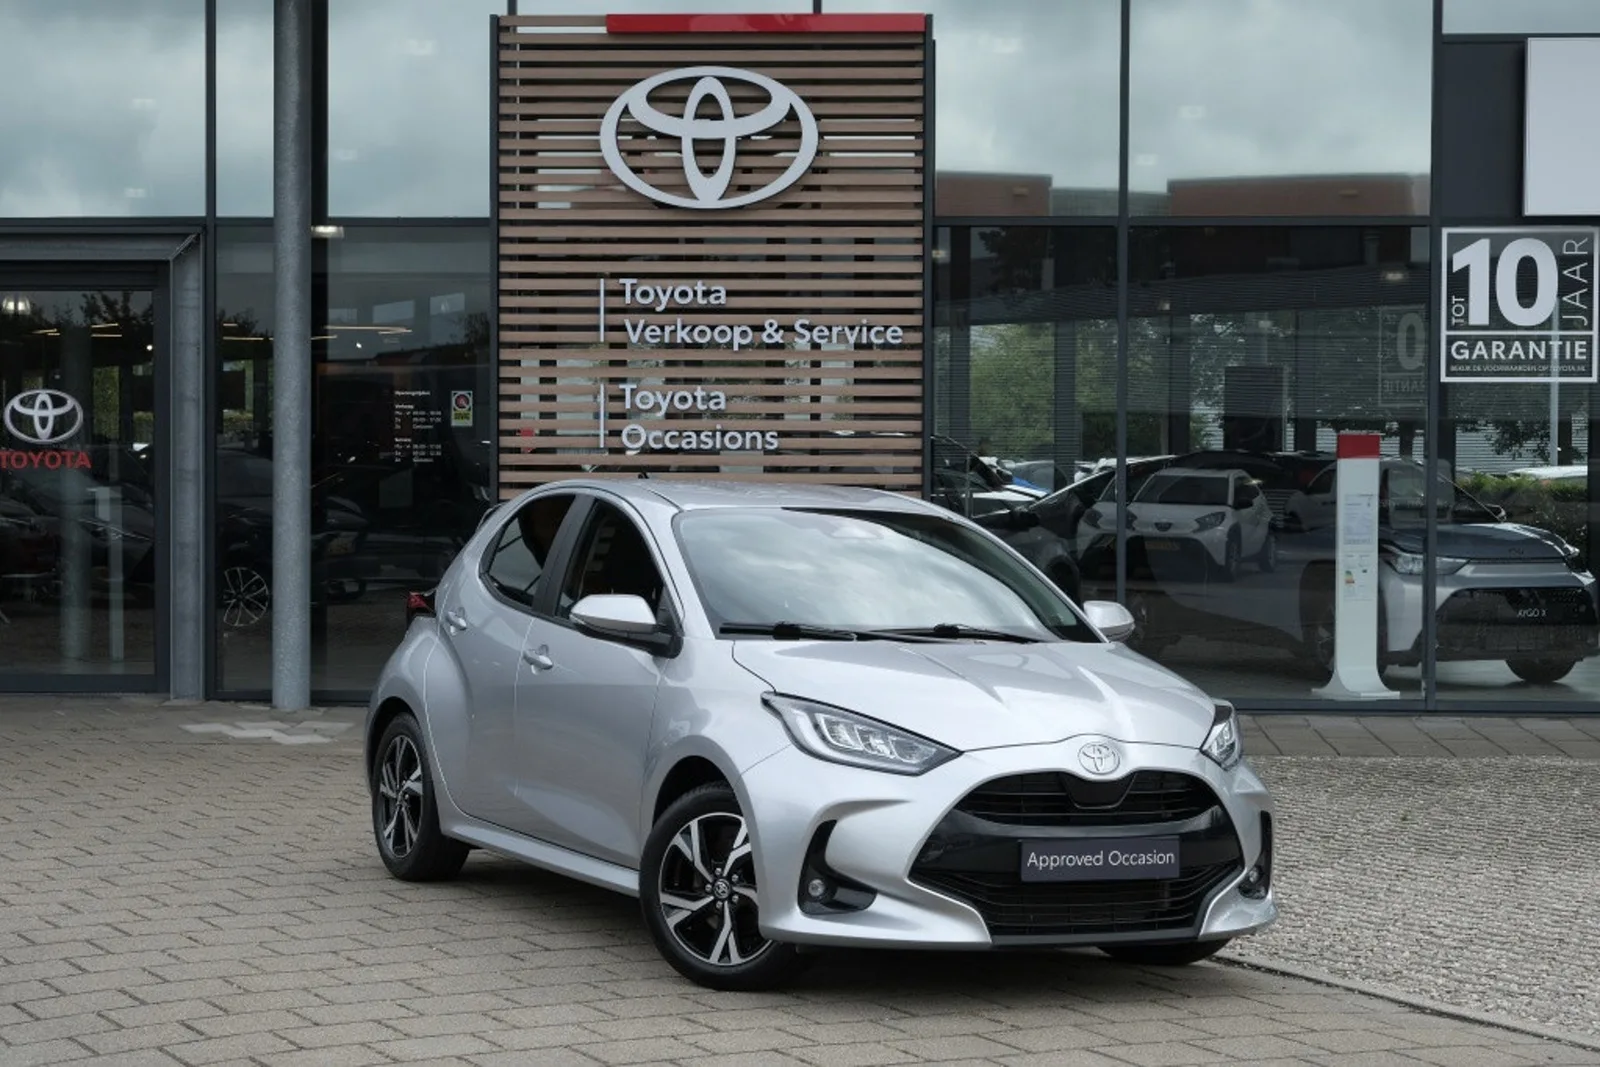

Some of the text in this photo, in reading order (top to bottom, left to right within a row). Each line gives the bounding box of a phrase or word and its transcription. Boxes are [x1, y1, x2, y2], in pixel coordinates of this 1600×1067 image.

[619, 278, 727, 312] Toyota
[1452, 237, 1559, 327] 10
[1562, 237, 1588, 326] JAAR
[1452, 295, 1465, 325] TOT
[624, 318, 903, 350] Verkoop & Service
[1451, 340, 1587, 360] GARANTIE
[619, 383, 727, 416] Toyota
[621, 424, 779, 451] Occasions
[0, 450, 92, 469] TOYOTA
[1027, 849, 1175, 870] Approved Occasion
